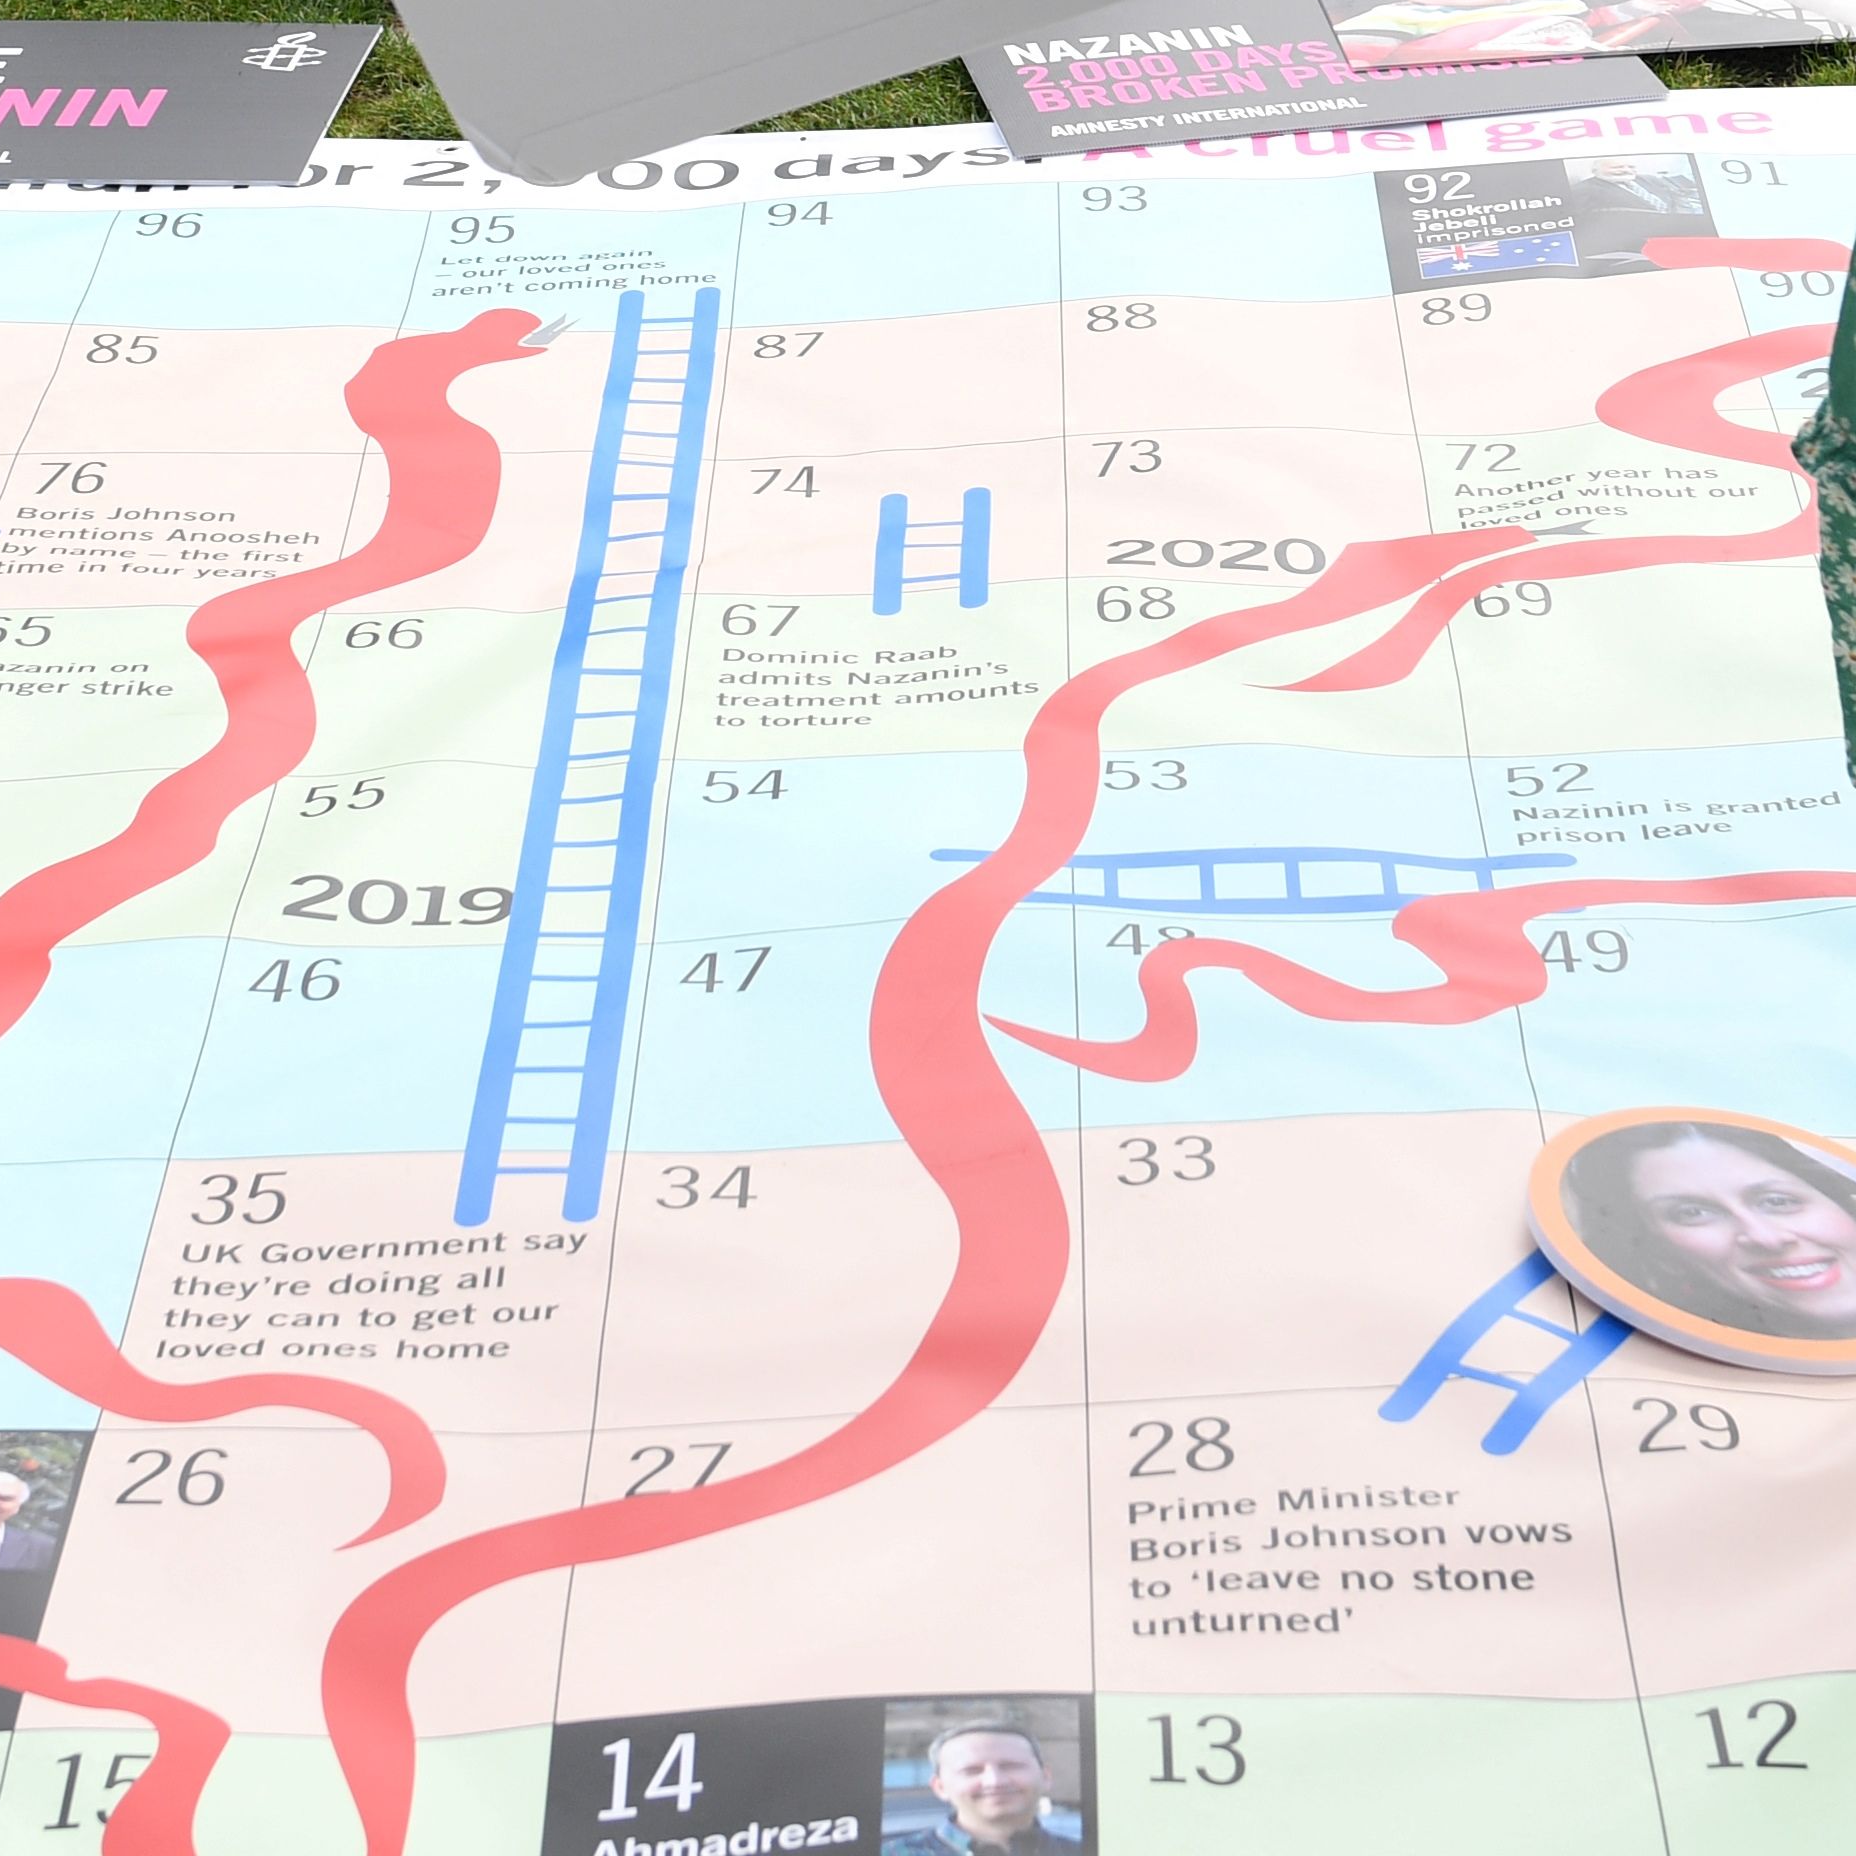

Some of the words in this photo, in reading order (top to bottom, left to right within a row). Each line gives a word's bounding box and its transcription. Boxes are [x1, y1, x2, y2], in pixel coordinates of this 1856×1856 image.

[1003, 25, 1254, 65] NAZANIN
[1016, 54, 1176, 91] 2,000
[1191, 41, 1337, 70] DAYS
[1027, 71, 1267, 113] BROKEN
[1050, 116, 1165, 137] AMNESTY
[1173, 96, 1367, 126] INTERNATIONAL
[1485, 110, 1774, 152] game
[1404, 172, 1474, 204] 92
[1412, 195, 1561, 222] Shokrollah
[1413, 214, 1496, 233] Jebeli
[1417, 217, 1574, 244] imprisoned
[441, 256, 484, 265] Let
[495, 254, 567, 263] down
[578, 249, 653, 261] again
[462, 267, 506, 278] our
[519, 264, 590, 275] loved
[603, 260, 666, 271] ones
[525, 277, 628, 291] coming
[640, 273, 717, 286] home
[85, 334, 159, 364] 85
[1444, 443, 1522, 472] 72
[34, 462, 109, 495] 76
[1453, 471, 1575, 499] Another
[1585, 466, 1651, 486] year
[1664, 465, 1719, 480] has
[16, 506, 96, 521] Boris
[107, 506, 236, 522] Johnson
[1456, 490, 1566, 519] passed
[1575, 481, 1695, 502] without
[1708, 484, 1759, 501] our
[1459, 510, 1542, 530] loved
[1554, 502, 1628, 517] ones
[8, 525, 154, 542] mentions
[166, 528, 320, 546] Anoosheh
[1, 542, 38, 560] by
[49, 547, 136, 558] name
[179, 547, 232, 562] the
[243, 548, 303, 564] first
[1106, 538, 1326, 576] 2020
[78, 561, 108, 575] in
[120, 562, 181, 576] four
[194, 565, 277, 581] years
[719, 603, 802, 637] 67
[110, 662, 149, 672] on
[721, 647, 859, 665] Dominic
[874, 644, 958, 664] Raab
[81, 680, 174, 698] strike
[716, 690, 883, 707] treatment
[893, 678, 1040, 706] amounts
[717, 668, 831, 687] admits
[713, 714, 745, 728] to
[758, 712, 873, 728] torture
[1512, 799, 1648, 820] Nazinin
[1663, 797, 1692, 814] is
[1705, 792, 1842, 817] granted
[1516, 825, 1626, 845] prison
[1641, 817, 1732, 841] leave
[281, 874, 514, 927] 2019
[189, 1172, 288, 1226] 35
[180, 1242, 245, 1265] UK
[259, 1231, 507, 1265] Government
[521, 1229, 590, 1256] say
[327, 1268, 442, 1297] doing
[457, 1266, 505, 1289] all
[163, 1307, 249, 1332] they
[266, 1310, 340, 1329] can
[356, 1307, 396, 1327] to
[411, 1303, 476, 1330] get
[492, 1300, 559, 1324] our
[156, 1336, 265, 1362] loved
[282, 1342, 377, 1359] ones
[395, 1339, 511, 1359] home
[1126, 1415, 1235, 1478] 28
[1127, 1493, 1258, 1524] Prime
[1276, 1485, 1460, 1512] Minister
[1129, 1529, 1243, 1562] Boris
[1263, 1521, 1445, 1551] Johnson
[1466, 1520, 1573, 1543] vows
[1130, 1576, 1172, 1599] to
[1340, 1568, 1394, 1591] no
[1413, 1563, 1536, 1592] stone
[596, 1731, 703, 1822] 14
